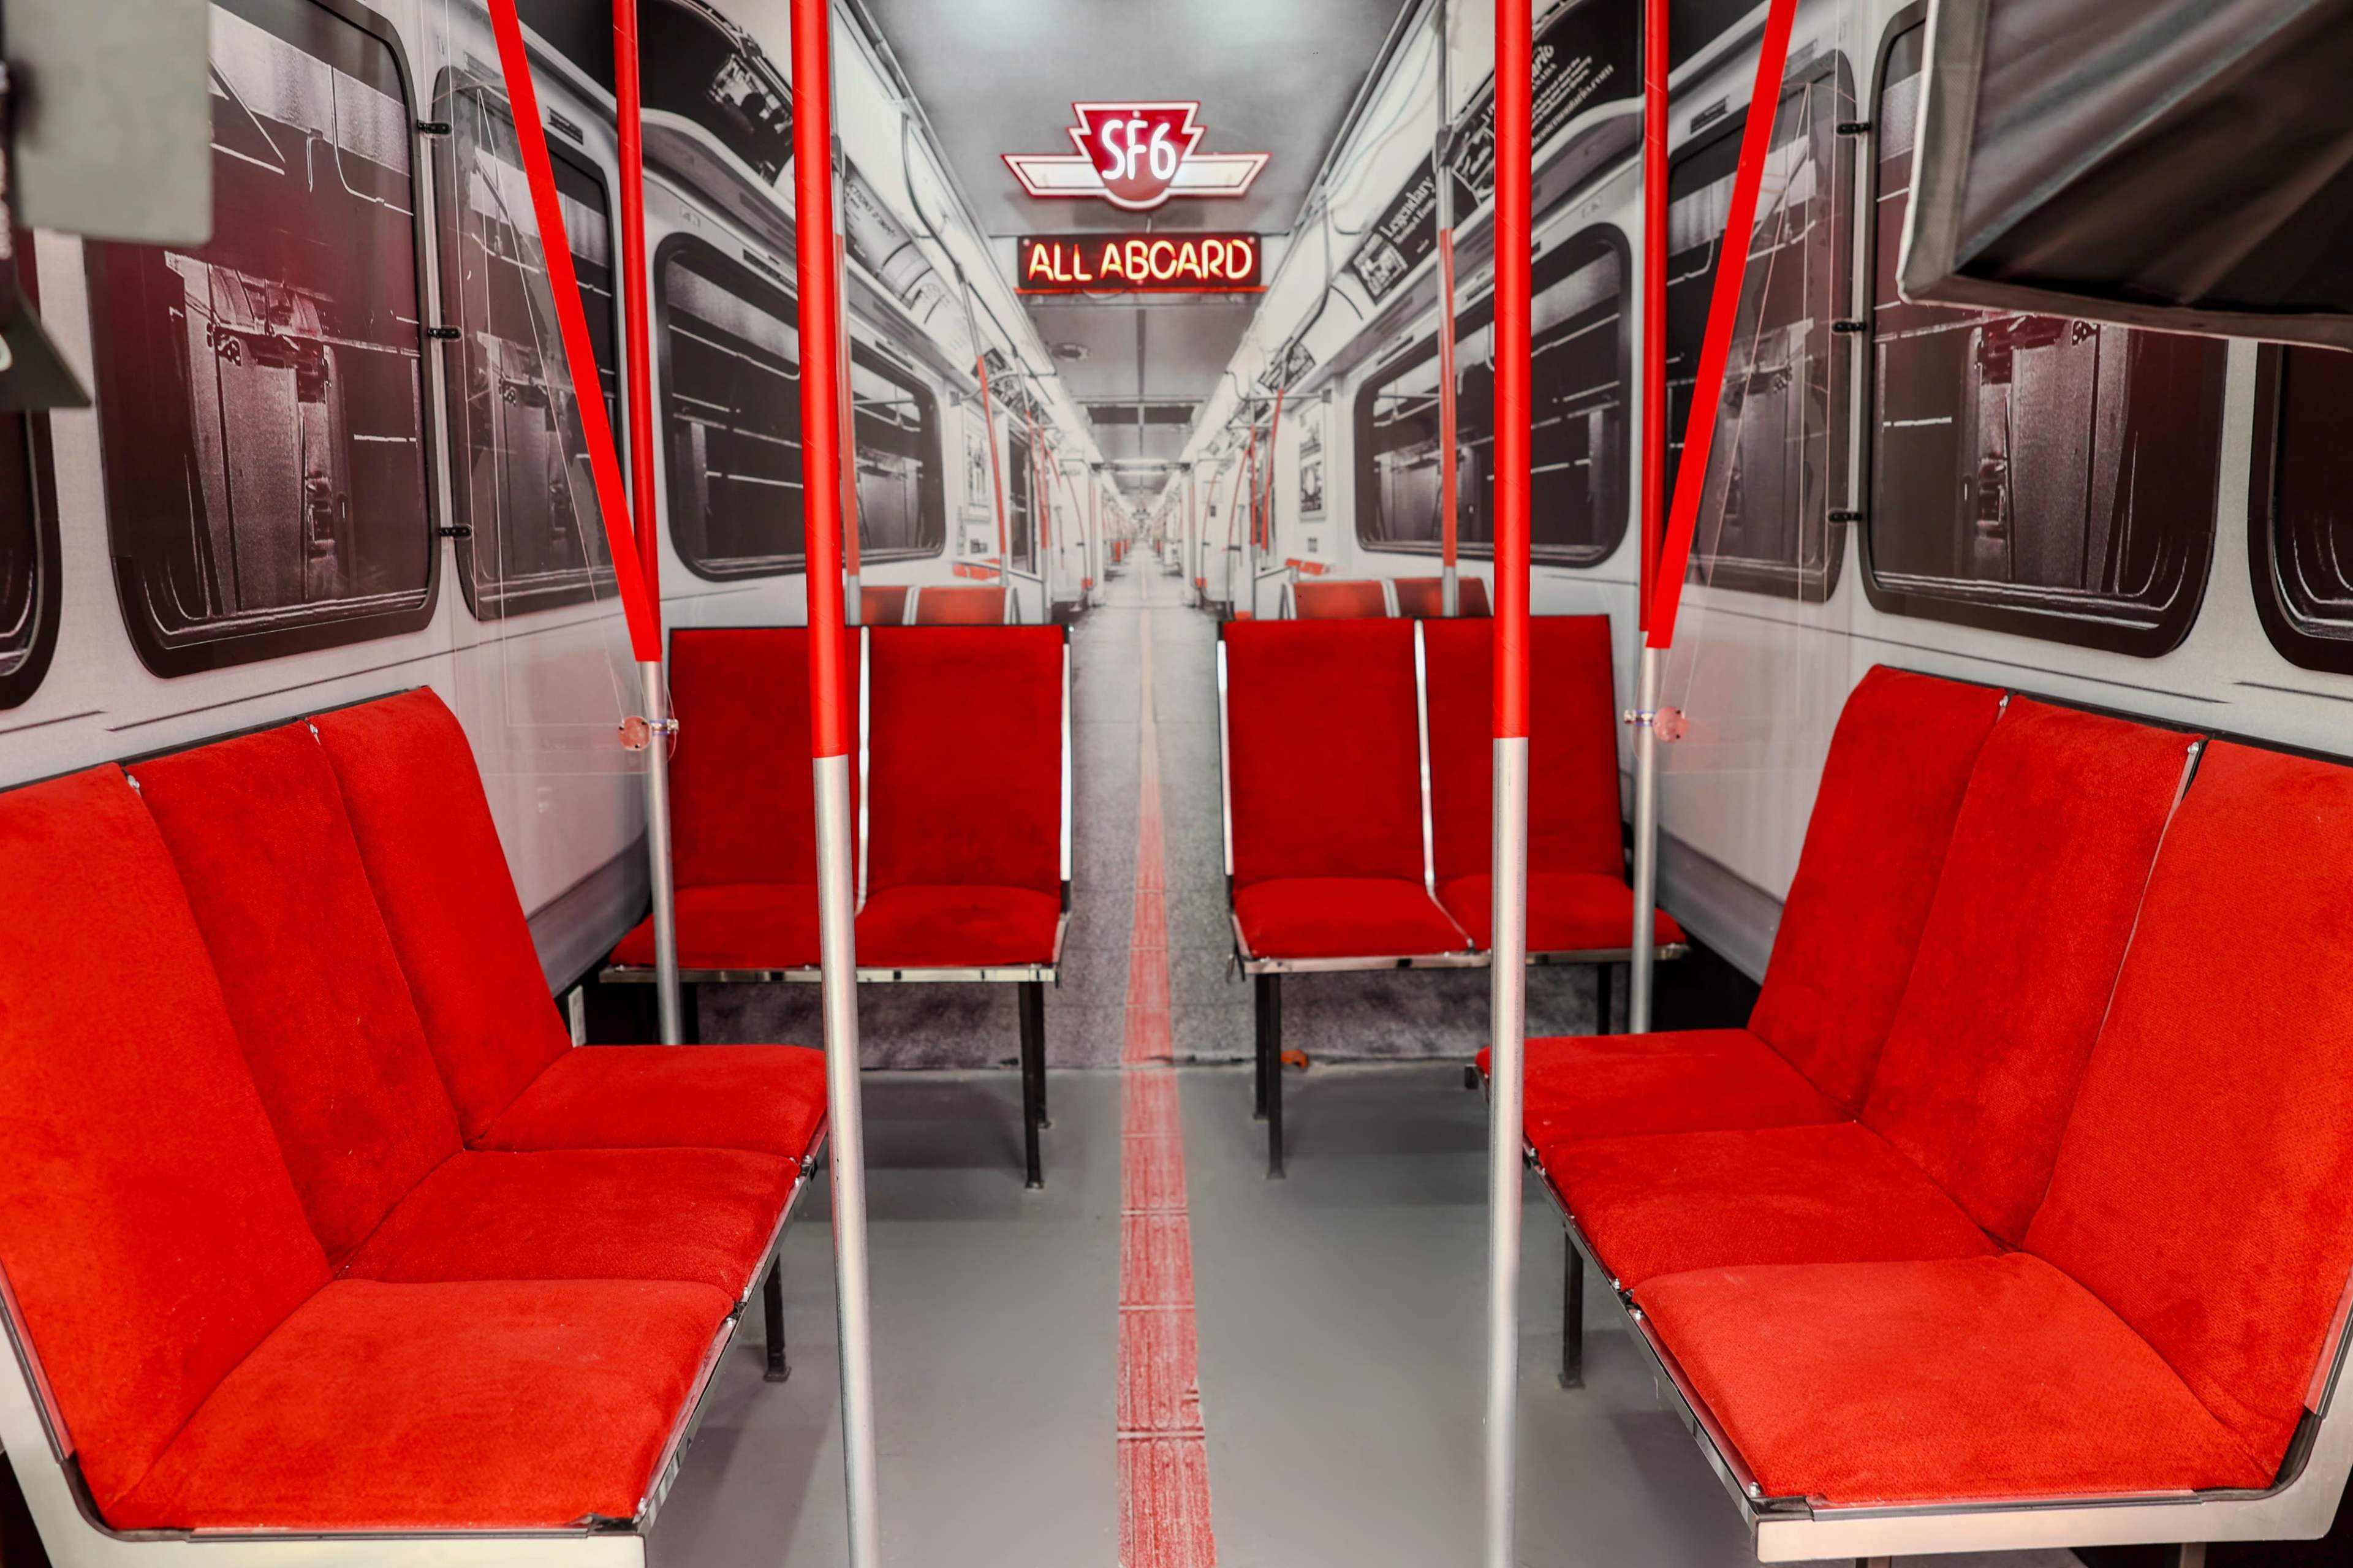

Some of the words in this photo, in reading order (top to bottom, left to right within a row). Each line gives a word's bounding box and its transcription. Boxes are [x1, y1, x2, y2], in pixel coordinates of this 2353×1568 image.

[1101, 119, 1177, 180] SF6
[1379, 176, 1436, 238] Legendary
[1028, 241, 1093, 281] ALL
[1101, 239, 1252, 279] ABOARD
